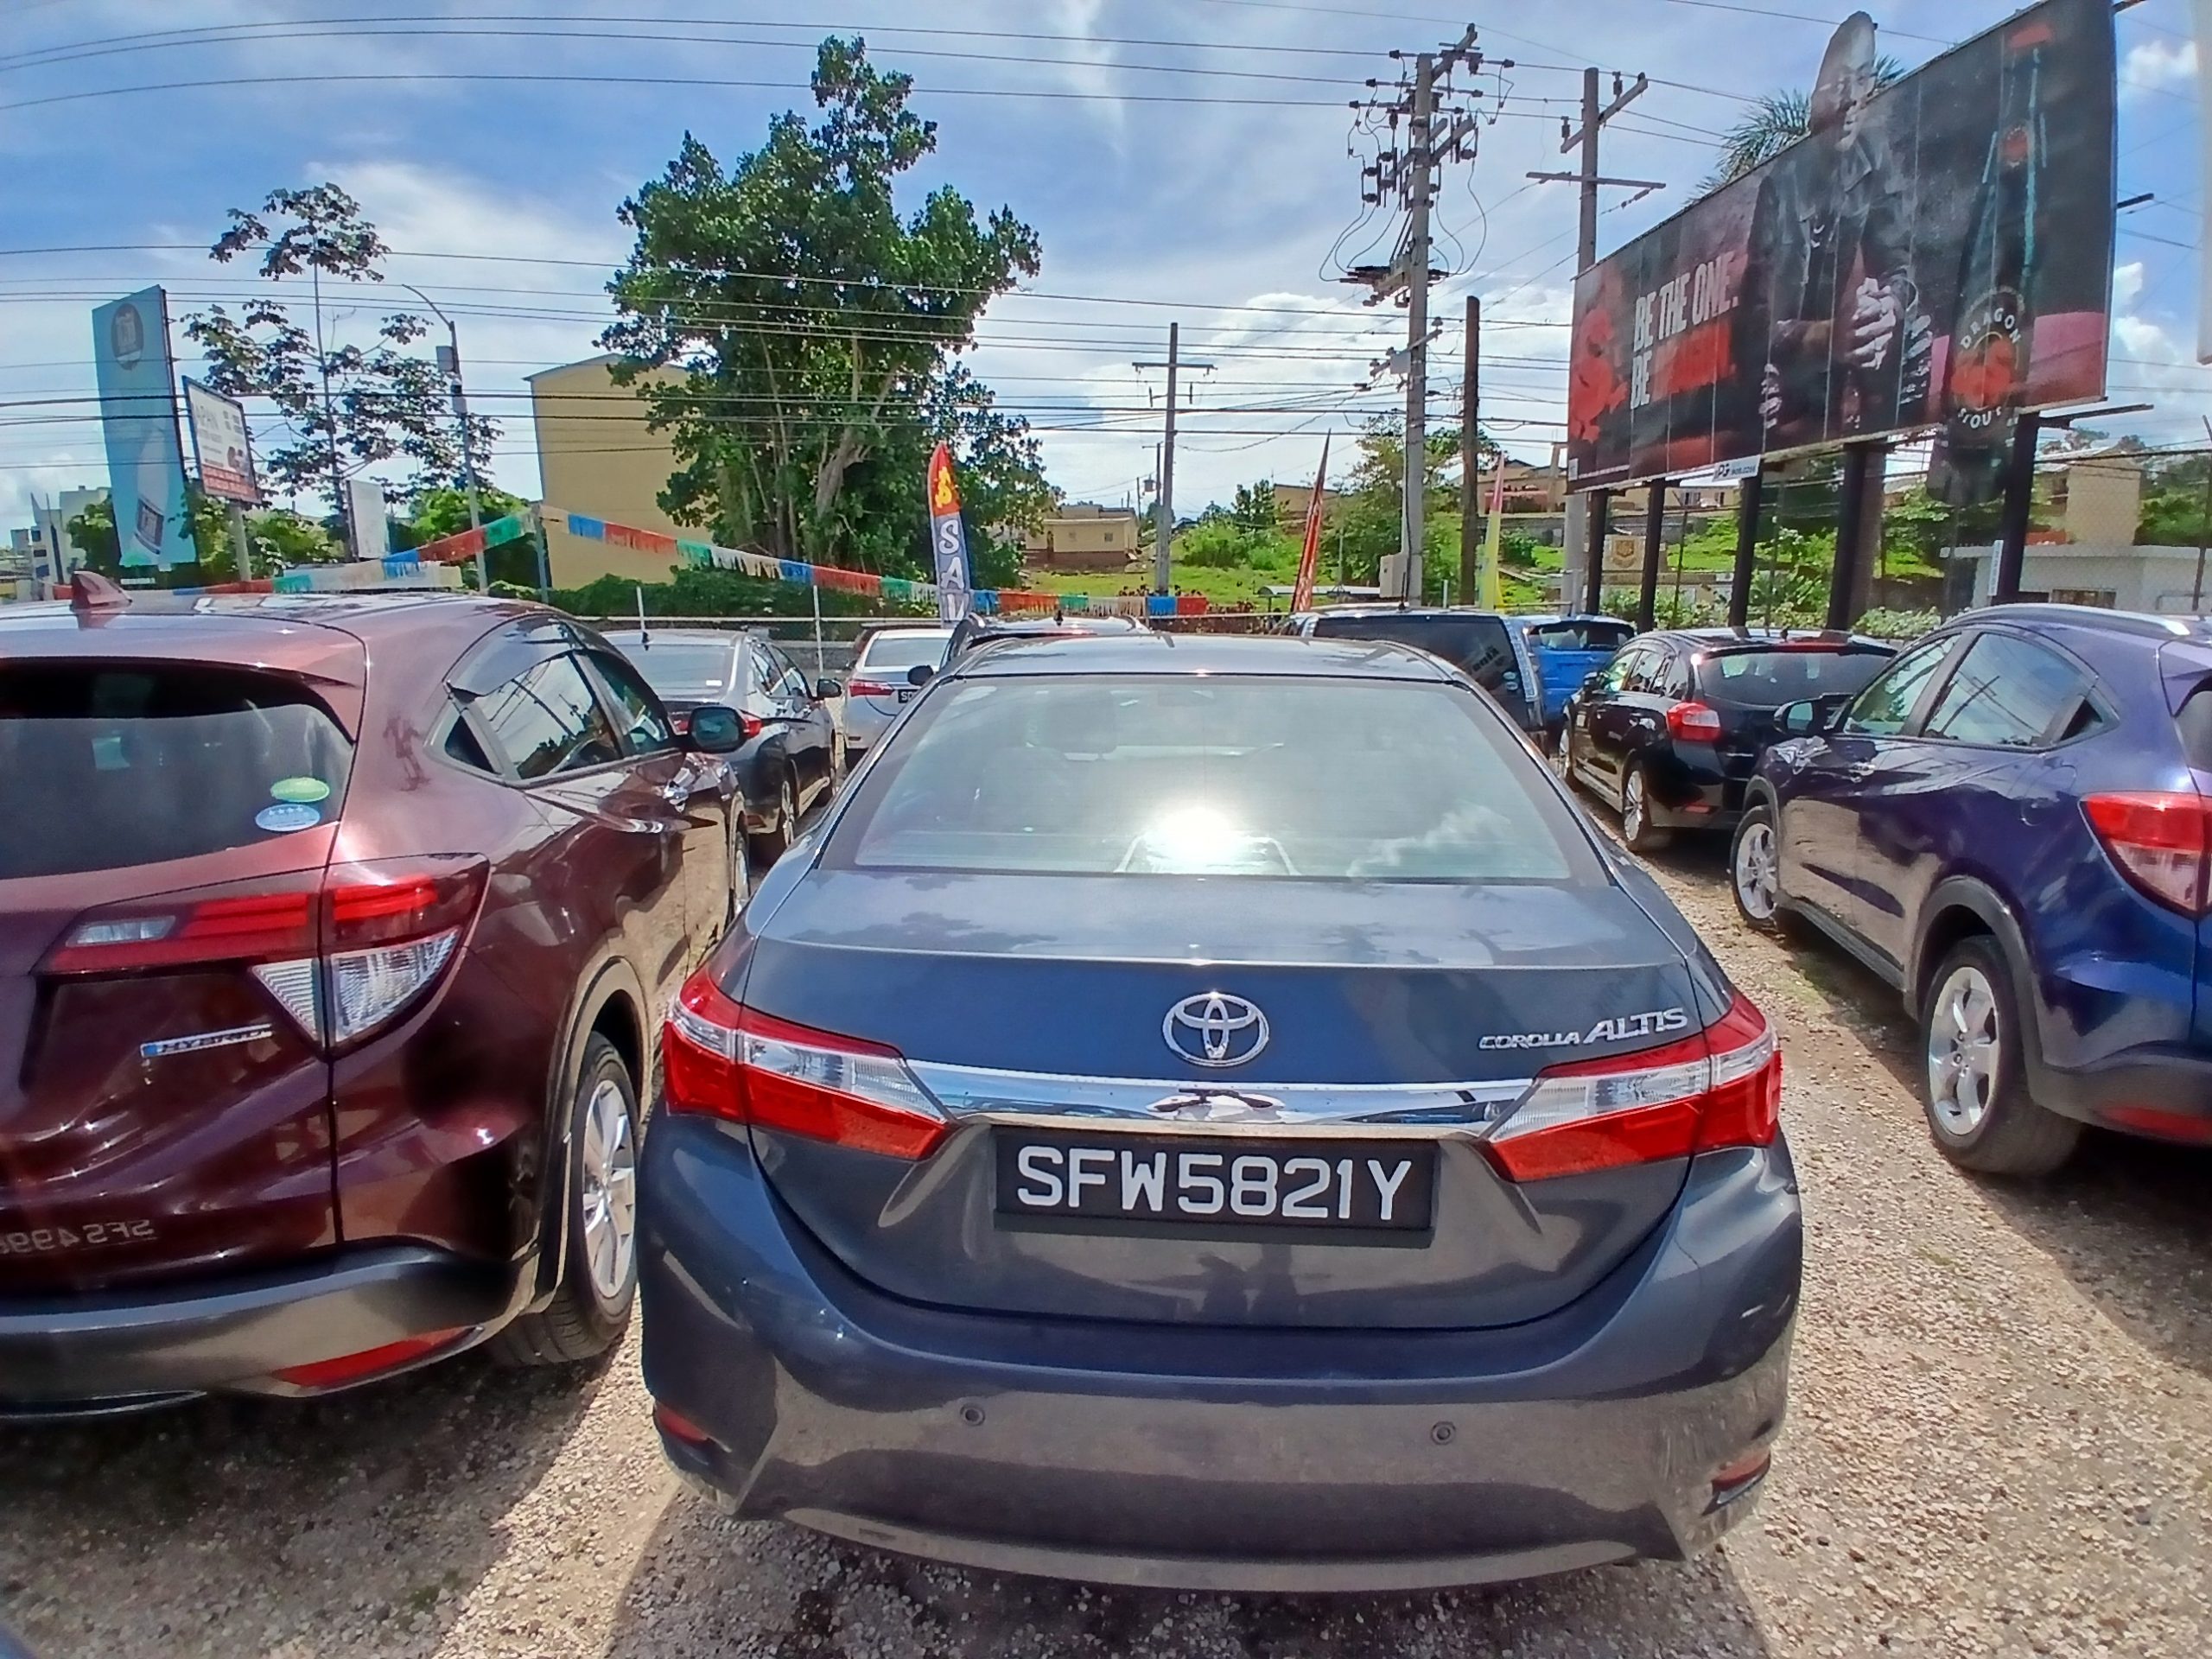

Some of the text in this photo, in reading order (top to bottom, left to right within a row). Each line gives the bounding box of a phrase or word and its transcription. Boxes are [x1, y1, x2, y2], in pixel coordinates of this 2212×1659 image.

[1633, 253, 1738, 353] BE THE ONE.
[1961, 307, 2021, 349] DRAGON
[1630, 350, 1652, 410] BE
[162, 1030, 263, 1052] HYBRID
[1478, 1007, 1688, 1049] COROLLA ALTIS
[1017, 1145, 1412, 1220] SFW5821Y
